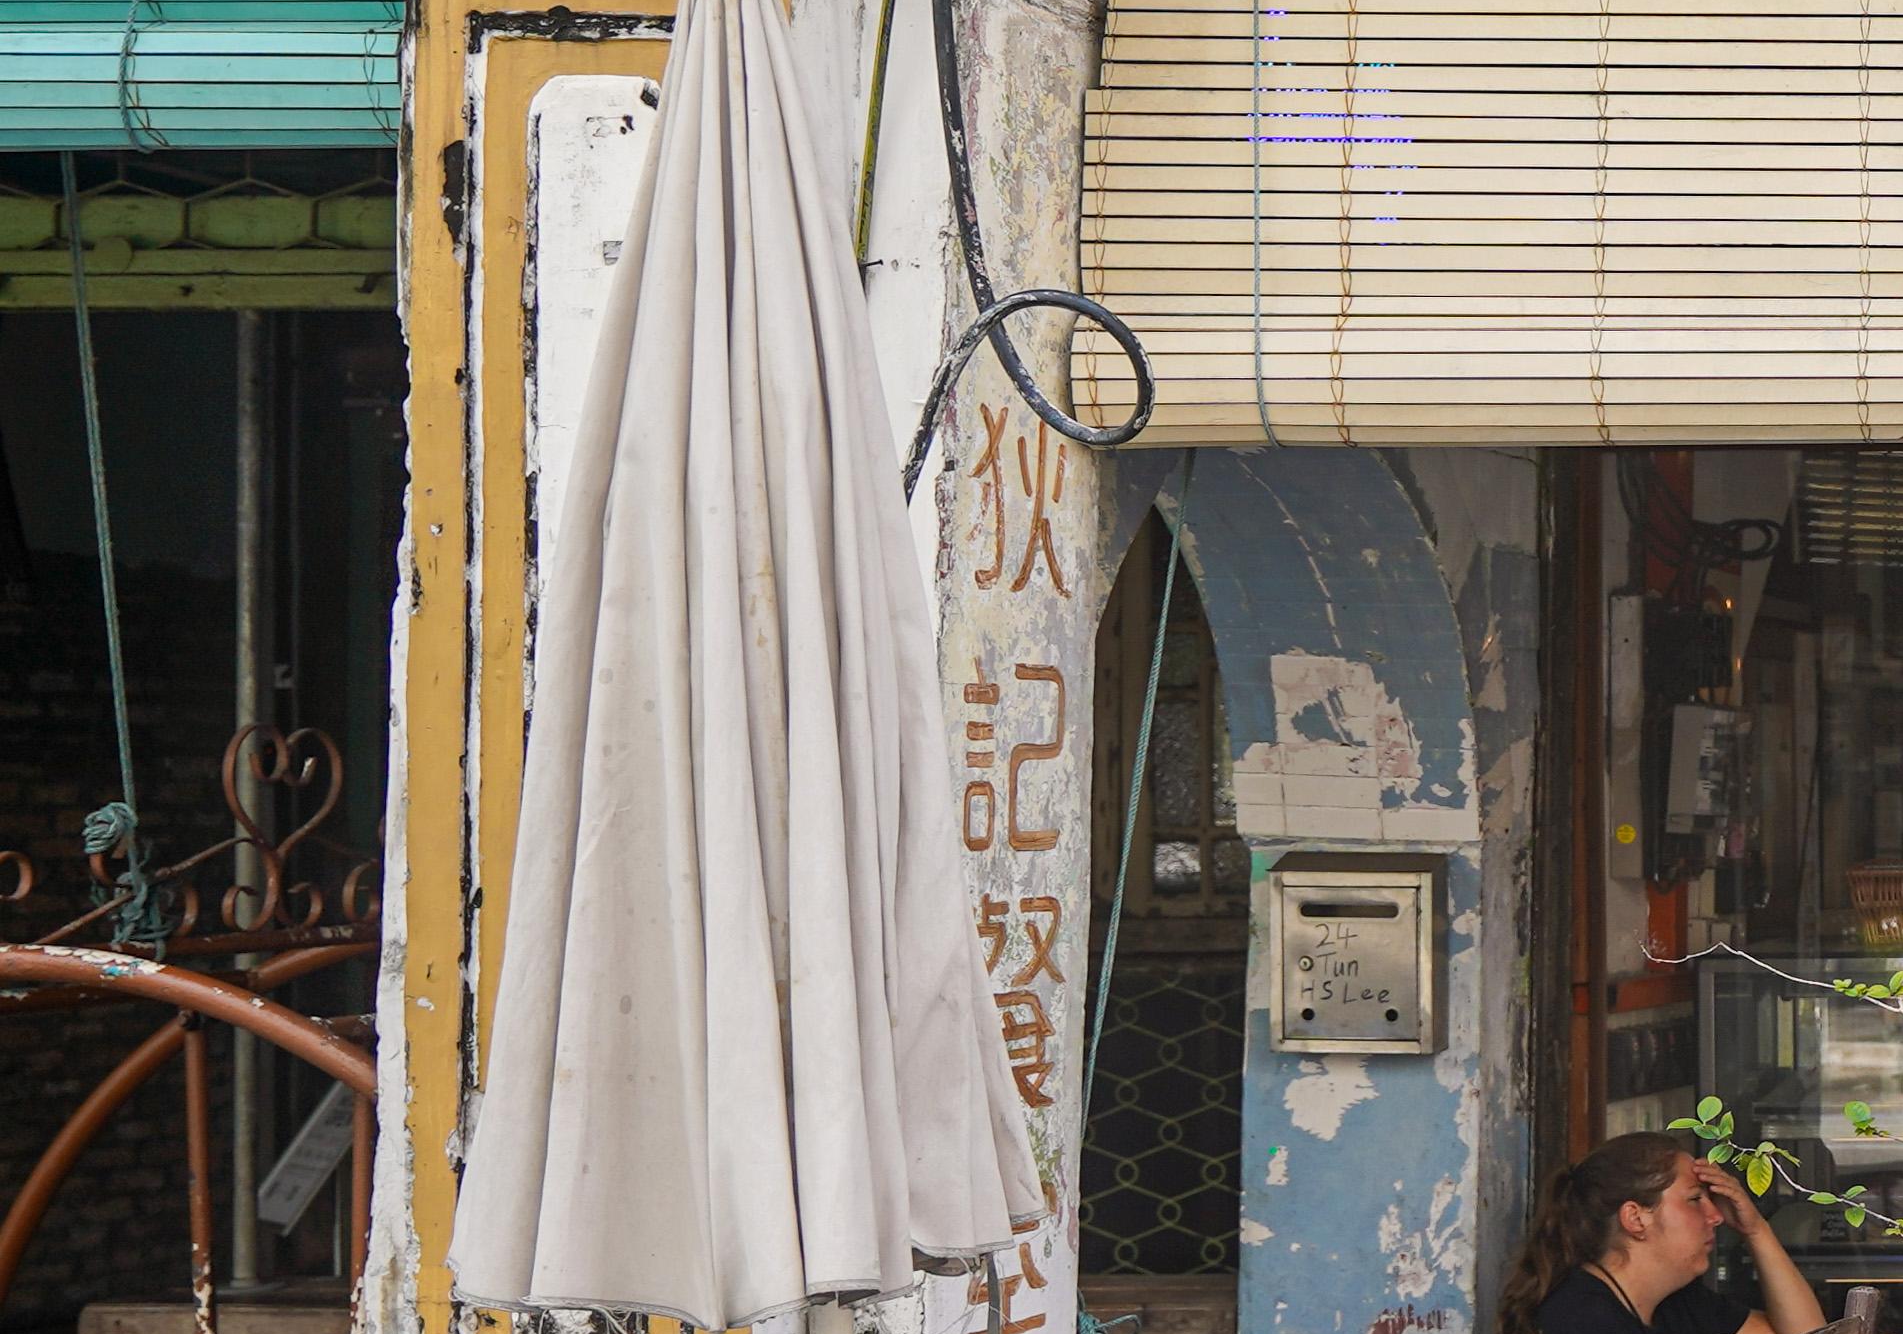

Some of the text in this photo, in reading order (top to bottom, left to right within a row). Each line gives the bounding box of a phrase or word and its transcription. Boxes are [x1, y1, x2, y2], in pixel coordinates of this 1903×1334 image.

[1314, 923, 1359, 948] 24
[1316, 951, 1360, 979] Tun
[1342, 984, 1391, 1005] Lee
